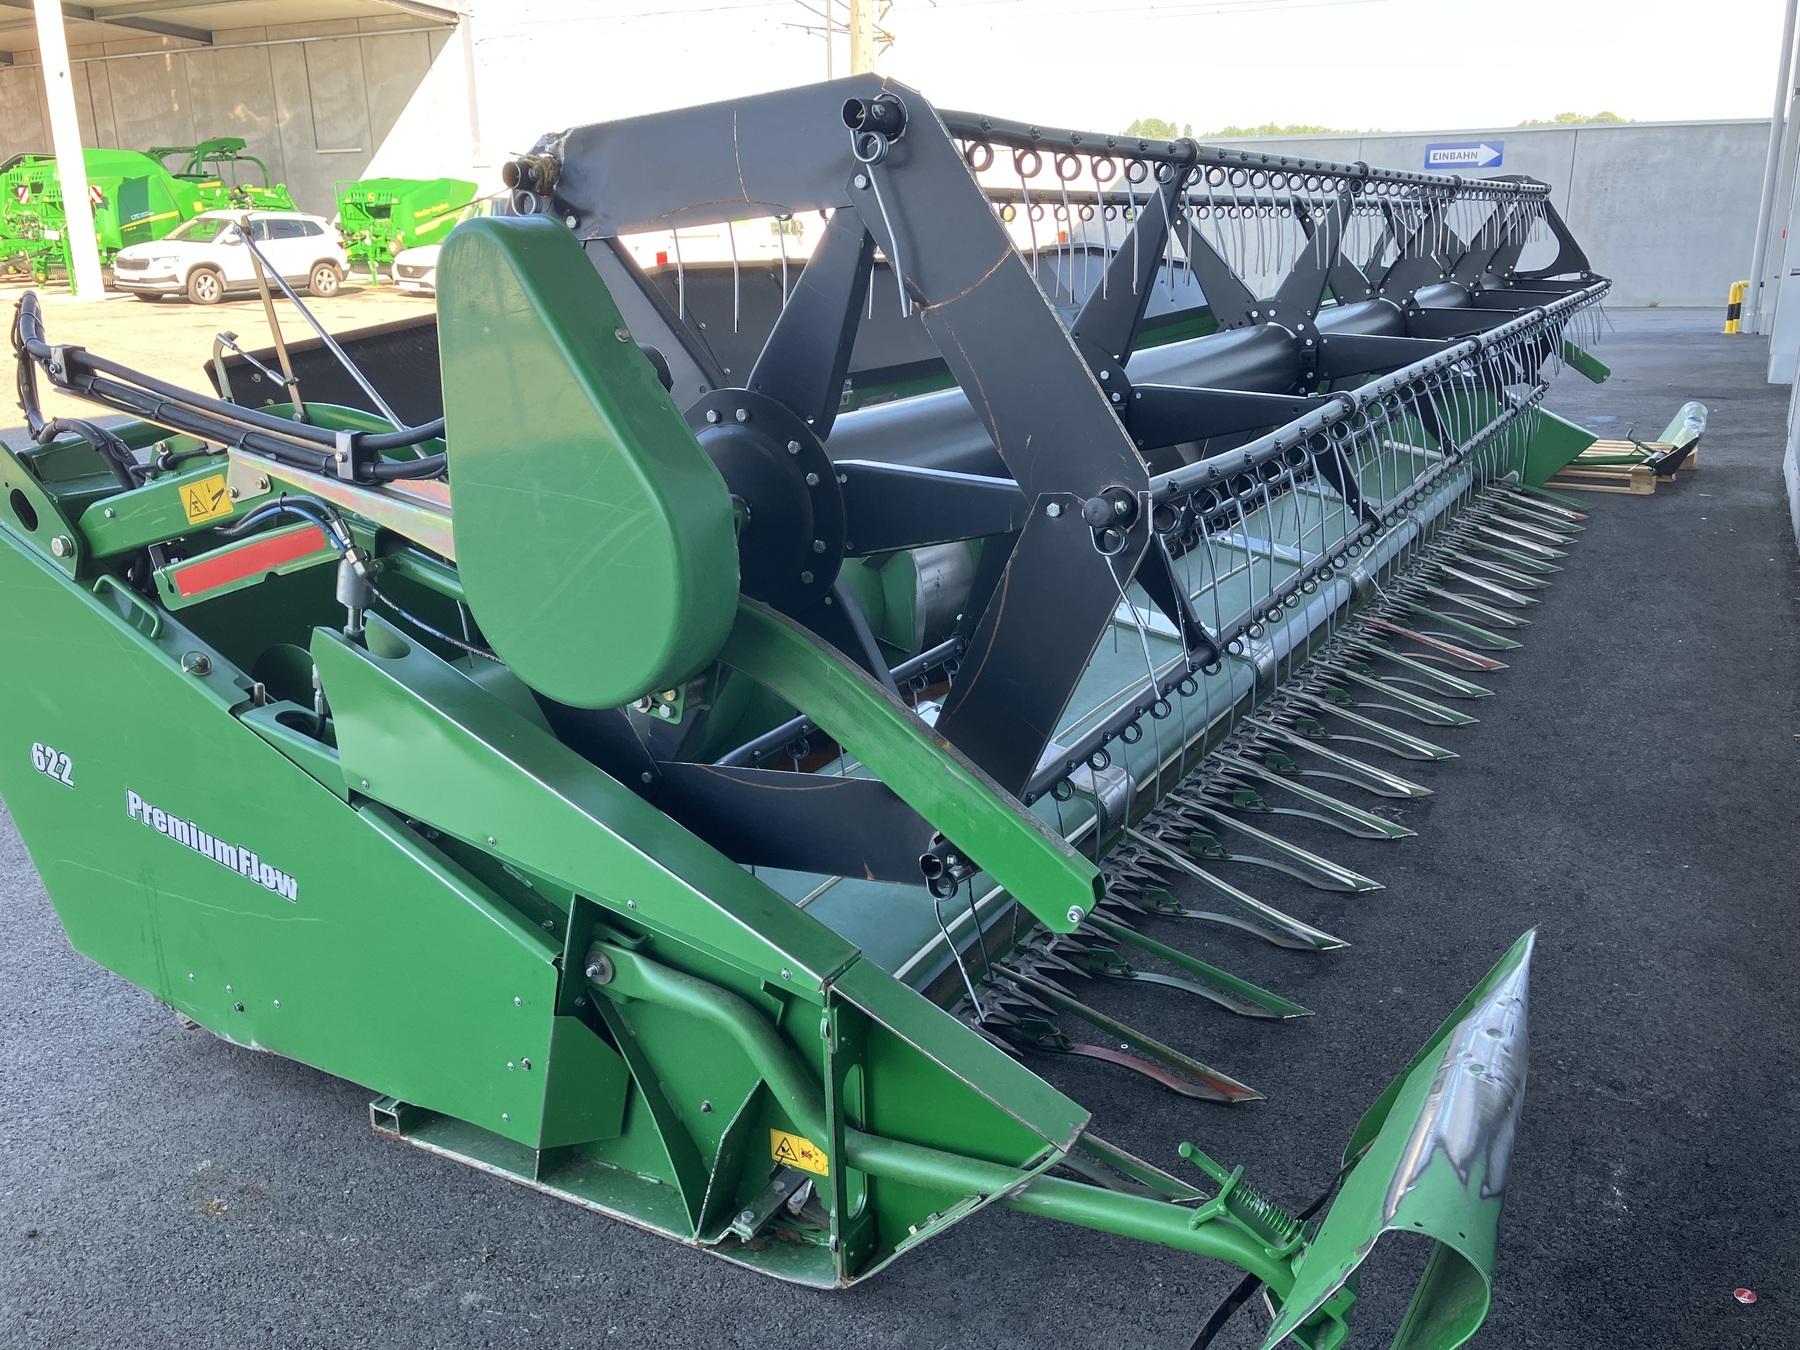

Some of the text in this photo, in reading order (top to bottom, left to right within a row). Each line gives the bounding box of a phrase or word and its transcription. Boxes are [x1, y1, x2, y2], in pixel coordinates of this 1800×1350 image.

[1432, 151, 1478, 160] EINBAHN
[31, 742, 75, 788] 622
[126, 788, 298, 903] PremiumFlow
